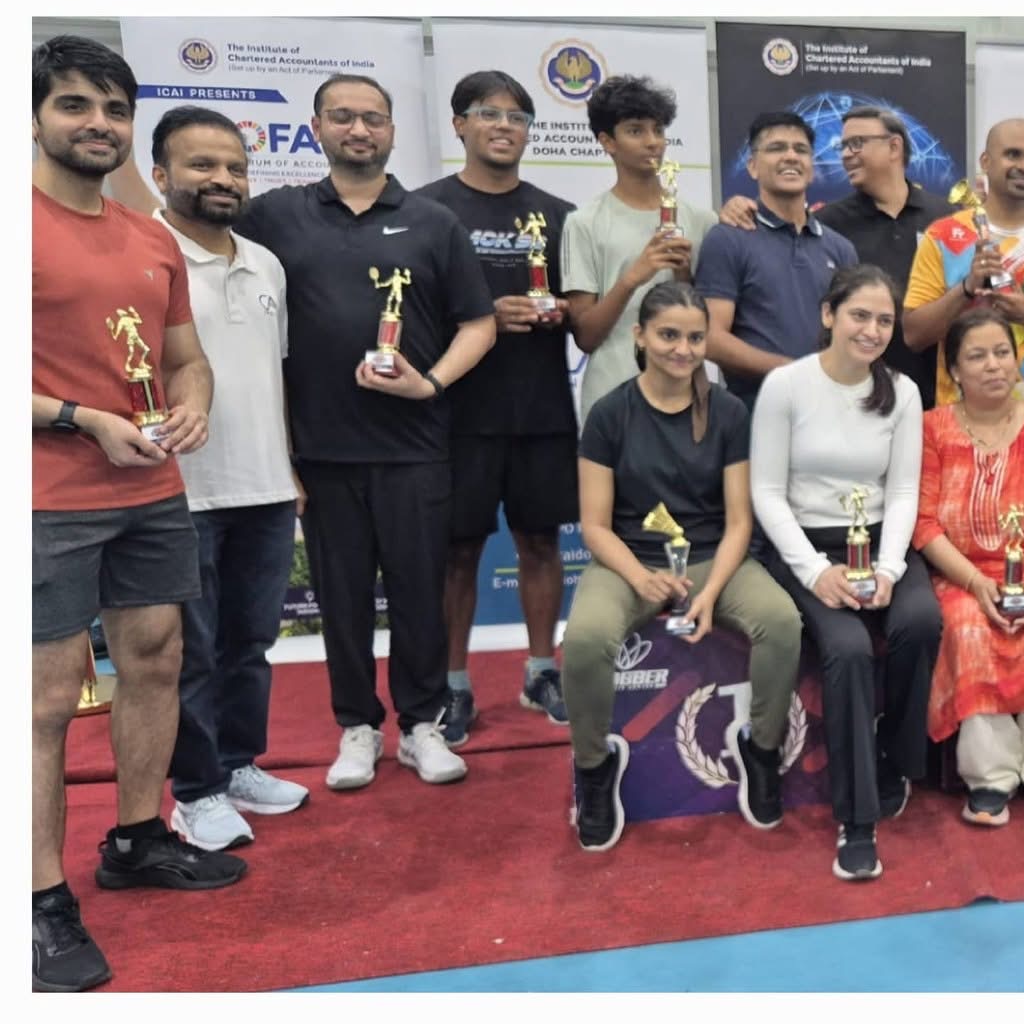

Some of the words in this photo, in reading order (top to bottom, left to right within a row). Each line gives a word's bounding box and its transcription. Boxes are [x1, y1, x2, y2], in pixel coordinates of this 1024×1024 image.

[227, 43, 245, 52] The
[247, 45, 288, 54] Institute
[290, 46, 301, 54] of
[805, 43, 821, 52] The
[822, 45, 858, 54] Institute
[859, 45, 869, 54] of
[227, 54, 277, 64] Chartered
[279, 57, 338, 67] Accountants
[340, 59, 351, 68] of
[352, 60, 376, 69] India
[805, 54, 848, 64] Chartered
[848, 56, 900, 65] Accountants
[900, 58, 910, 66] of
[911, 58, 932, 67] India
[157, 87, 184, 97] ICAI
[189, 89, 257, 100] PRESENTS
[550, 122, 590, 131] INSTIT
[236, 120, 323, 154] OFA
[544, 135, 593, 144] ACCOUN
[532, 146, 567, 156] DOHA
[570, 148, 603, 157] CHAP
